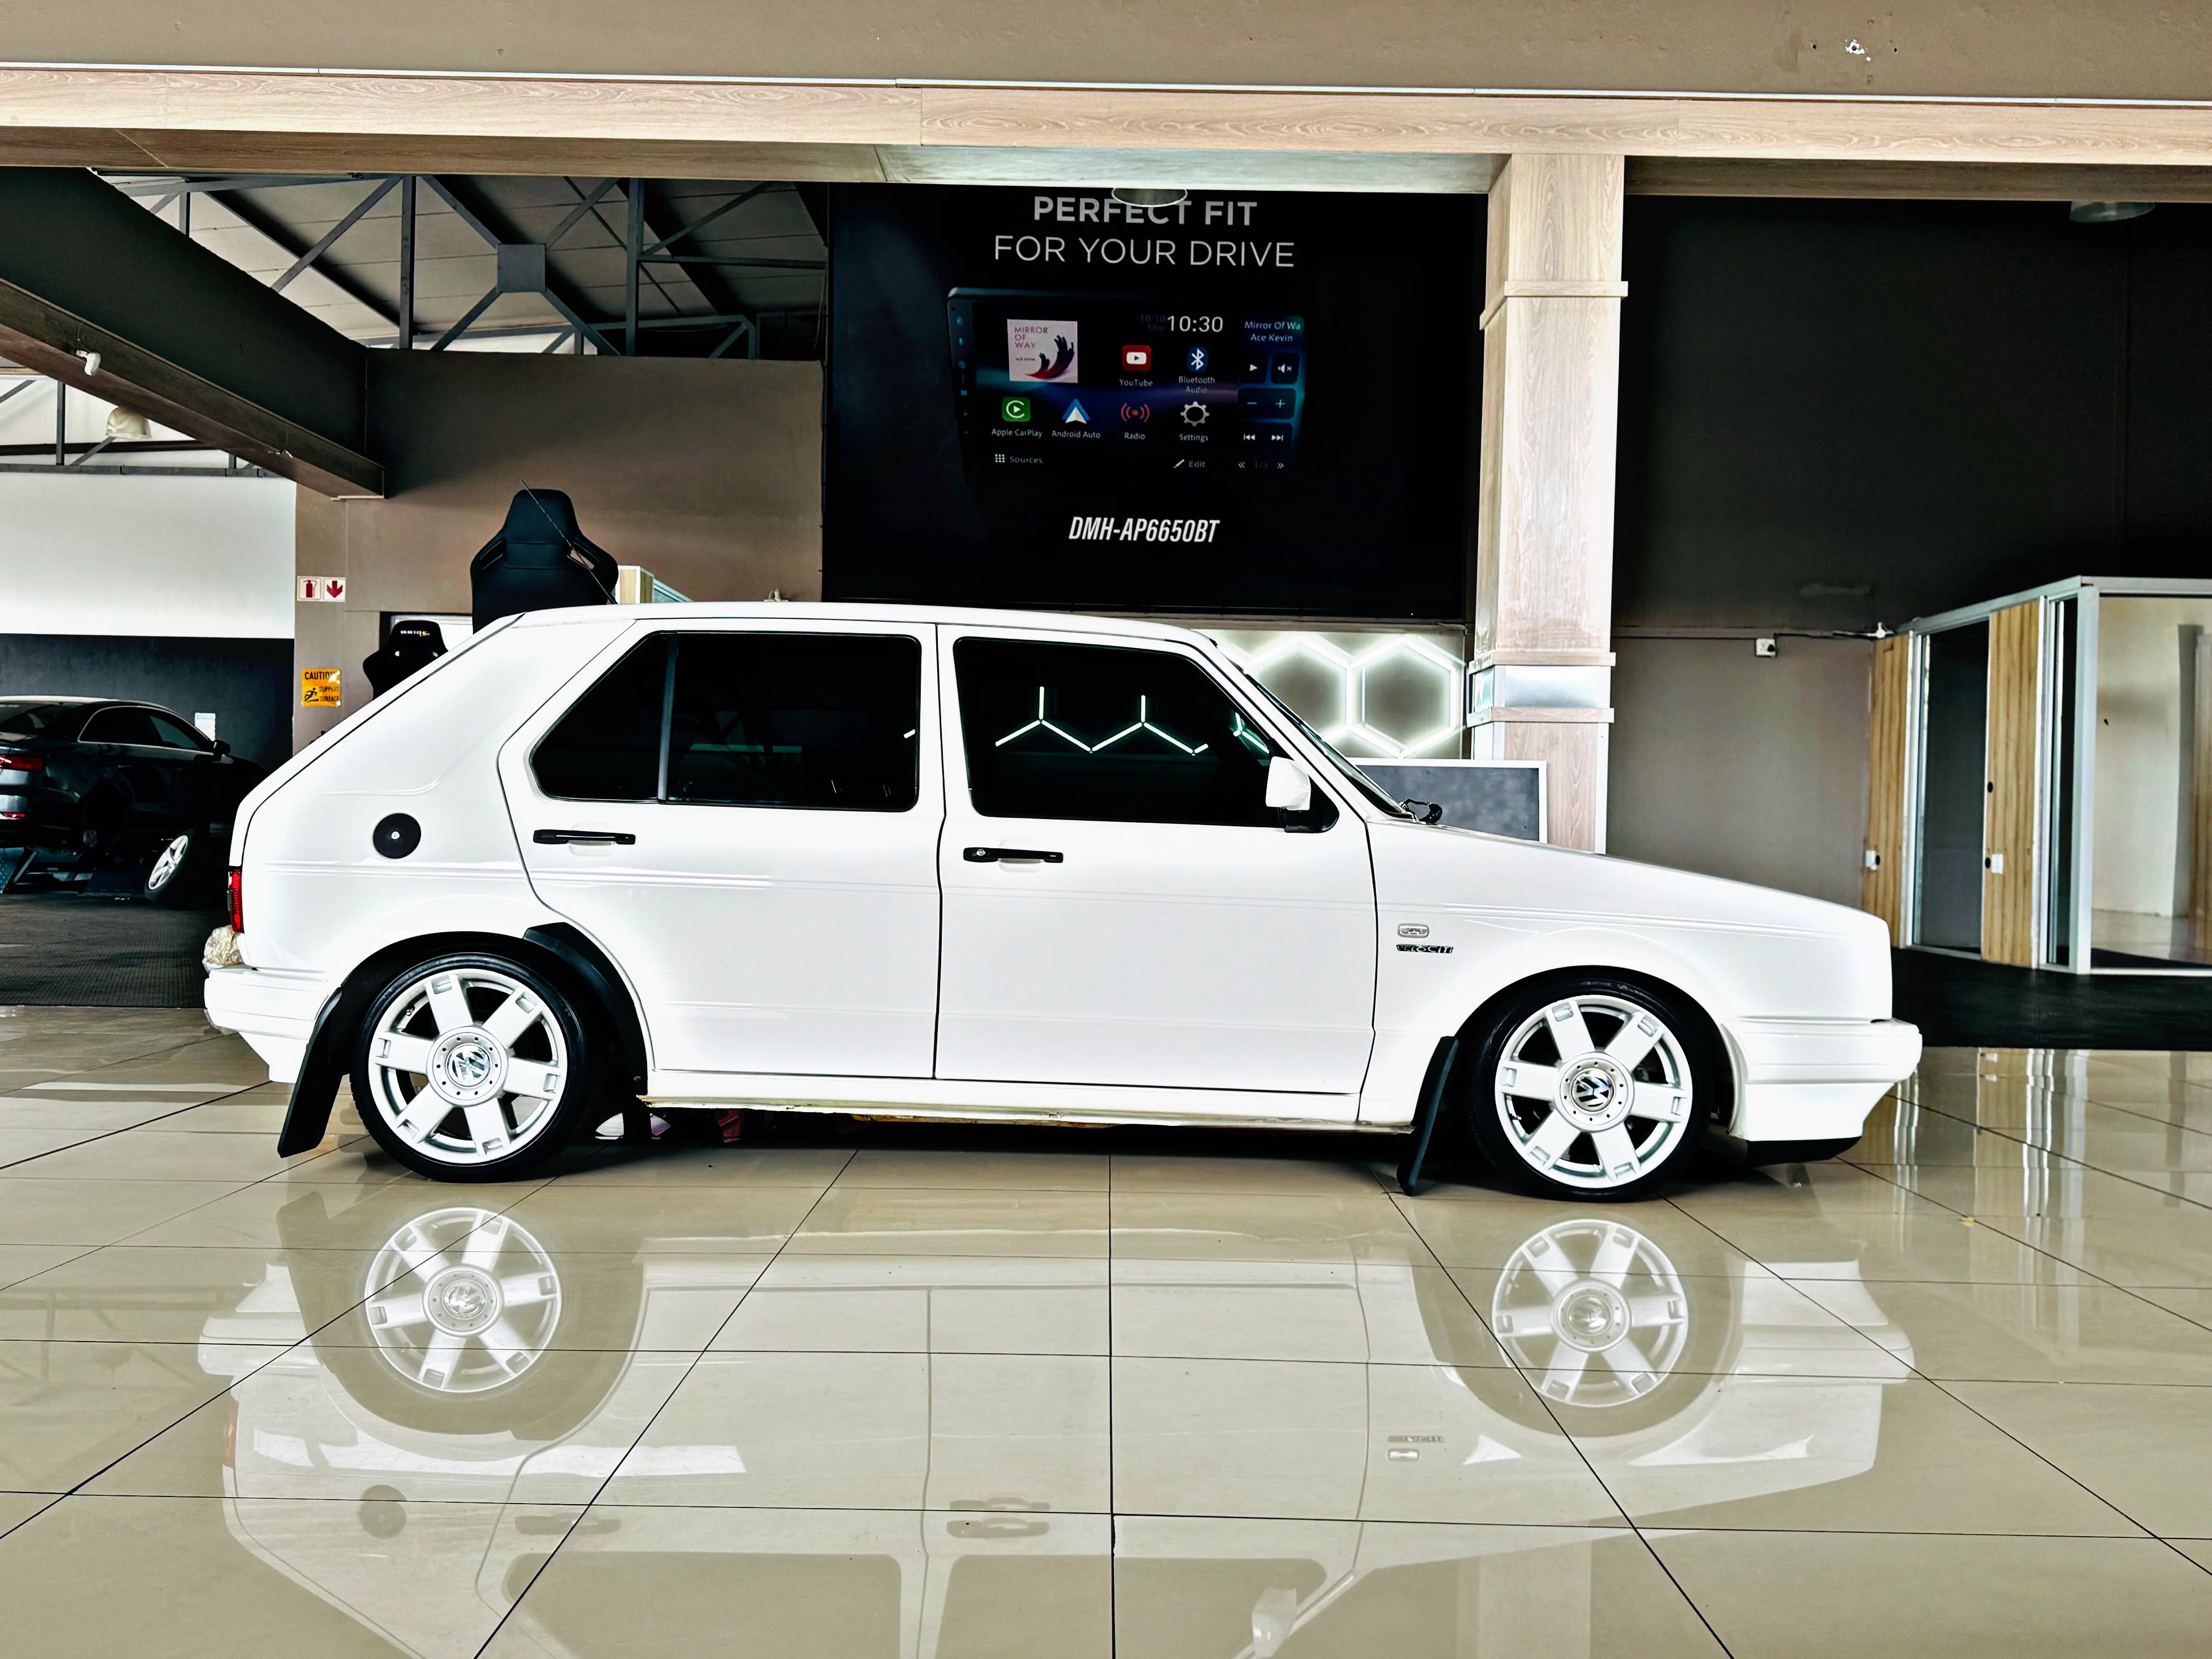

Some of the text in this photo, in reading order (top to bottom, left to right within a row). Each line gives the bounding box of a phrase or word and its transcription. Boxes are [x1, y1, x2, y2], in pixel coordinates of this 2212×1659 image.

[1034, 195, 1258, 226] PERFECT FIT
[995, 235, 1295, 267] FOR YOUR DRIVE
[1167, 315, 1224, 332] 10:30
[1244, 321, 1272, 330] Mirror
[1274, 321, 1286, 330] Of
[1250, 333, 1293, 342] Ace Kevin
[1119, 379, 1153, 387] YouTube
[1178, 376, 1215, 384] Bluetooth
[992, 429, 1043, 439] Apple CarPlay
[1179, 434, 1208, 443] Settings
[1010, 456, 1043, 464] Sources
[1068, 516, 1220, 542] DMH-AP6650BT
[305, 671, 335, 680] CAUTIO
